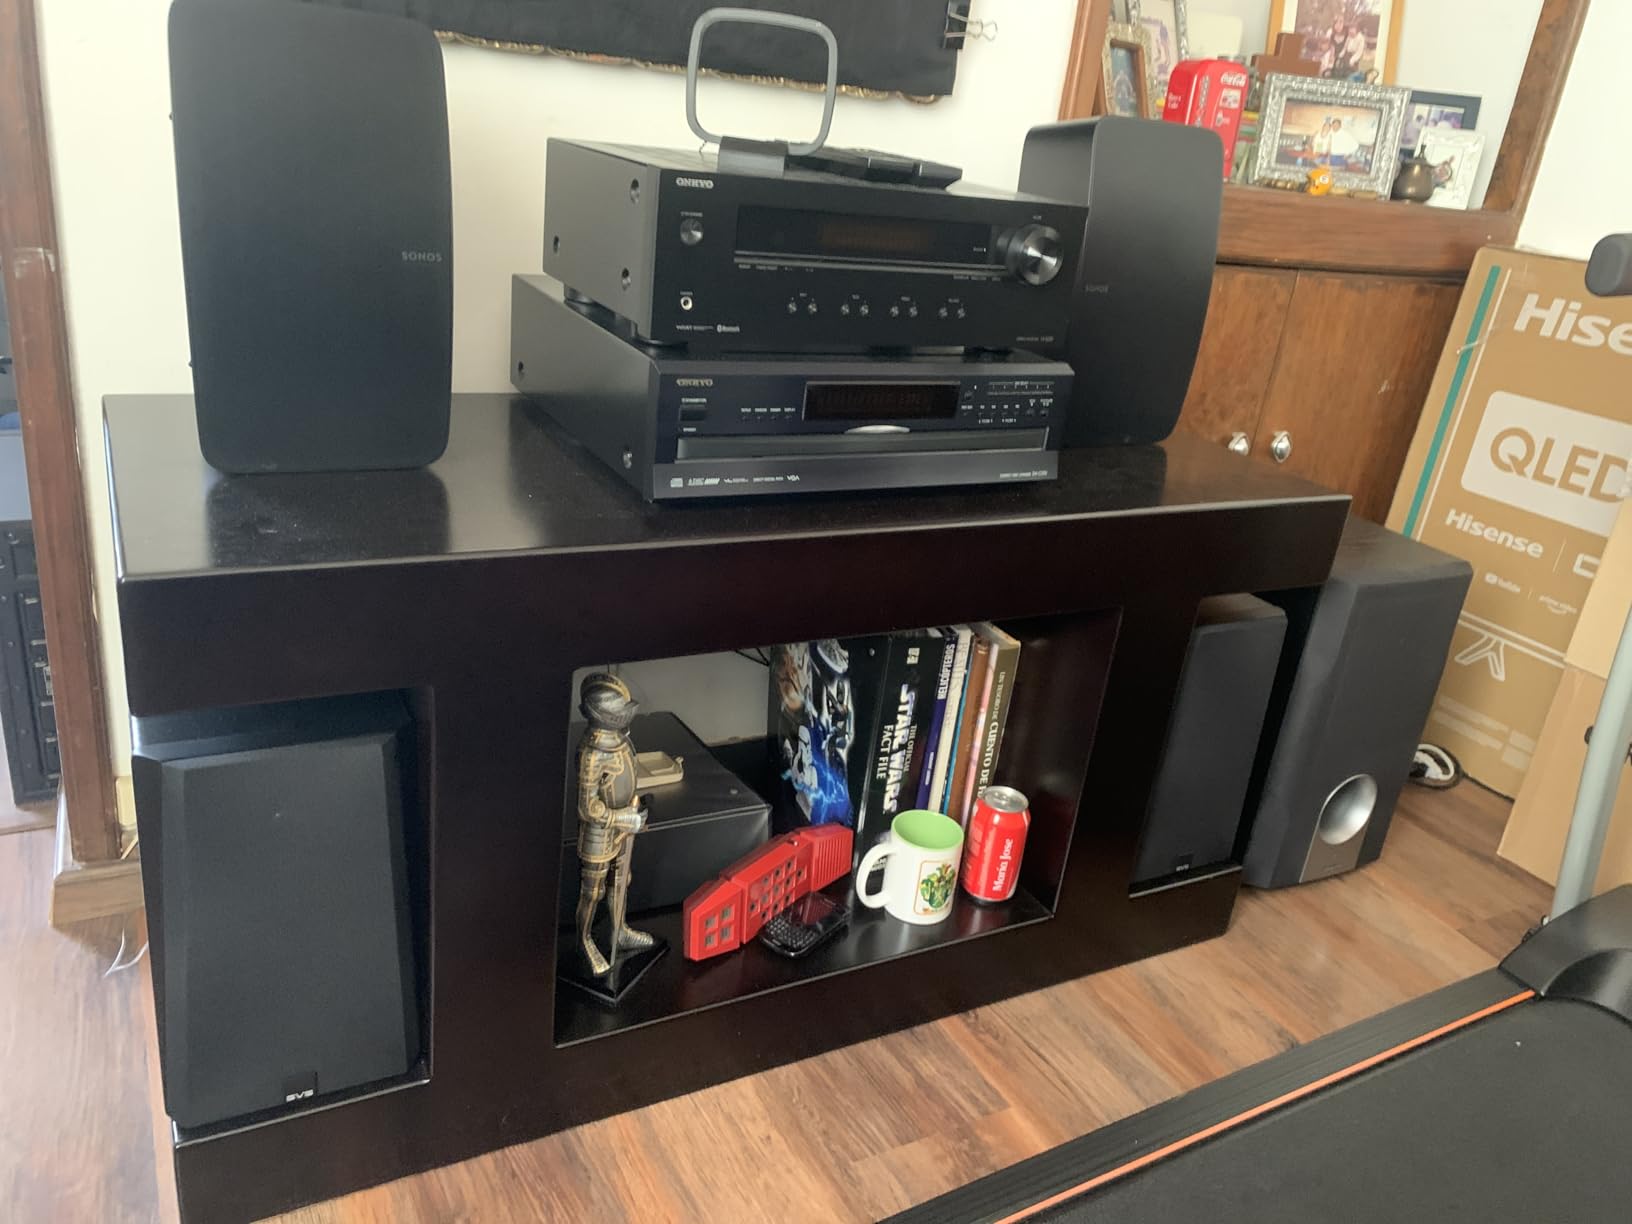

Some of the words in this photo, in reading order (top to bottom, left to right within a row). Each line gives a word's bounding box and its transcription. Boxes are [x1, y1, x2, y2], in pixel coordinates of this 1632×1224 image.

[675, 176, 714, 189] ONKYO
[401, 250, 442, 262] SONOS
[1513, 293, 1632, 356] Hise
[1490, 427, 1629, 503] QLED
[1445, 508, 1544, 559] Hisense
[892, 683, 916, 751] STAR
[880, 724, 894, 754] FACT
[983, 721, 999, 768] CUENTO
[876, 756, 889, 779] FILE
[883, 749, 906, 812] WARS
[979, 768, 990, 785] DE
[286, 1088, 314, 1103] SVS
